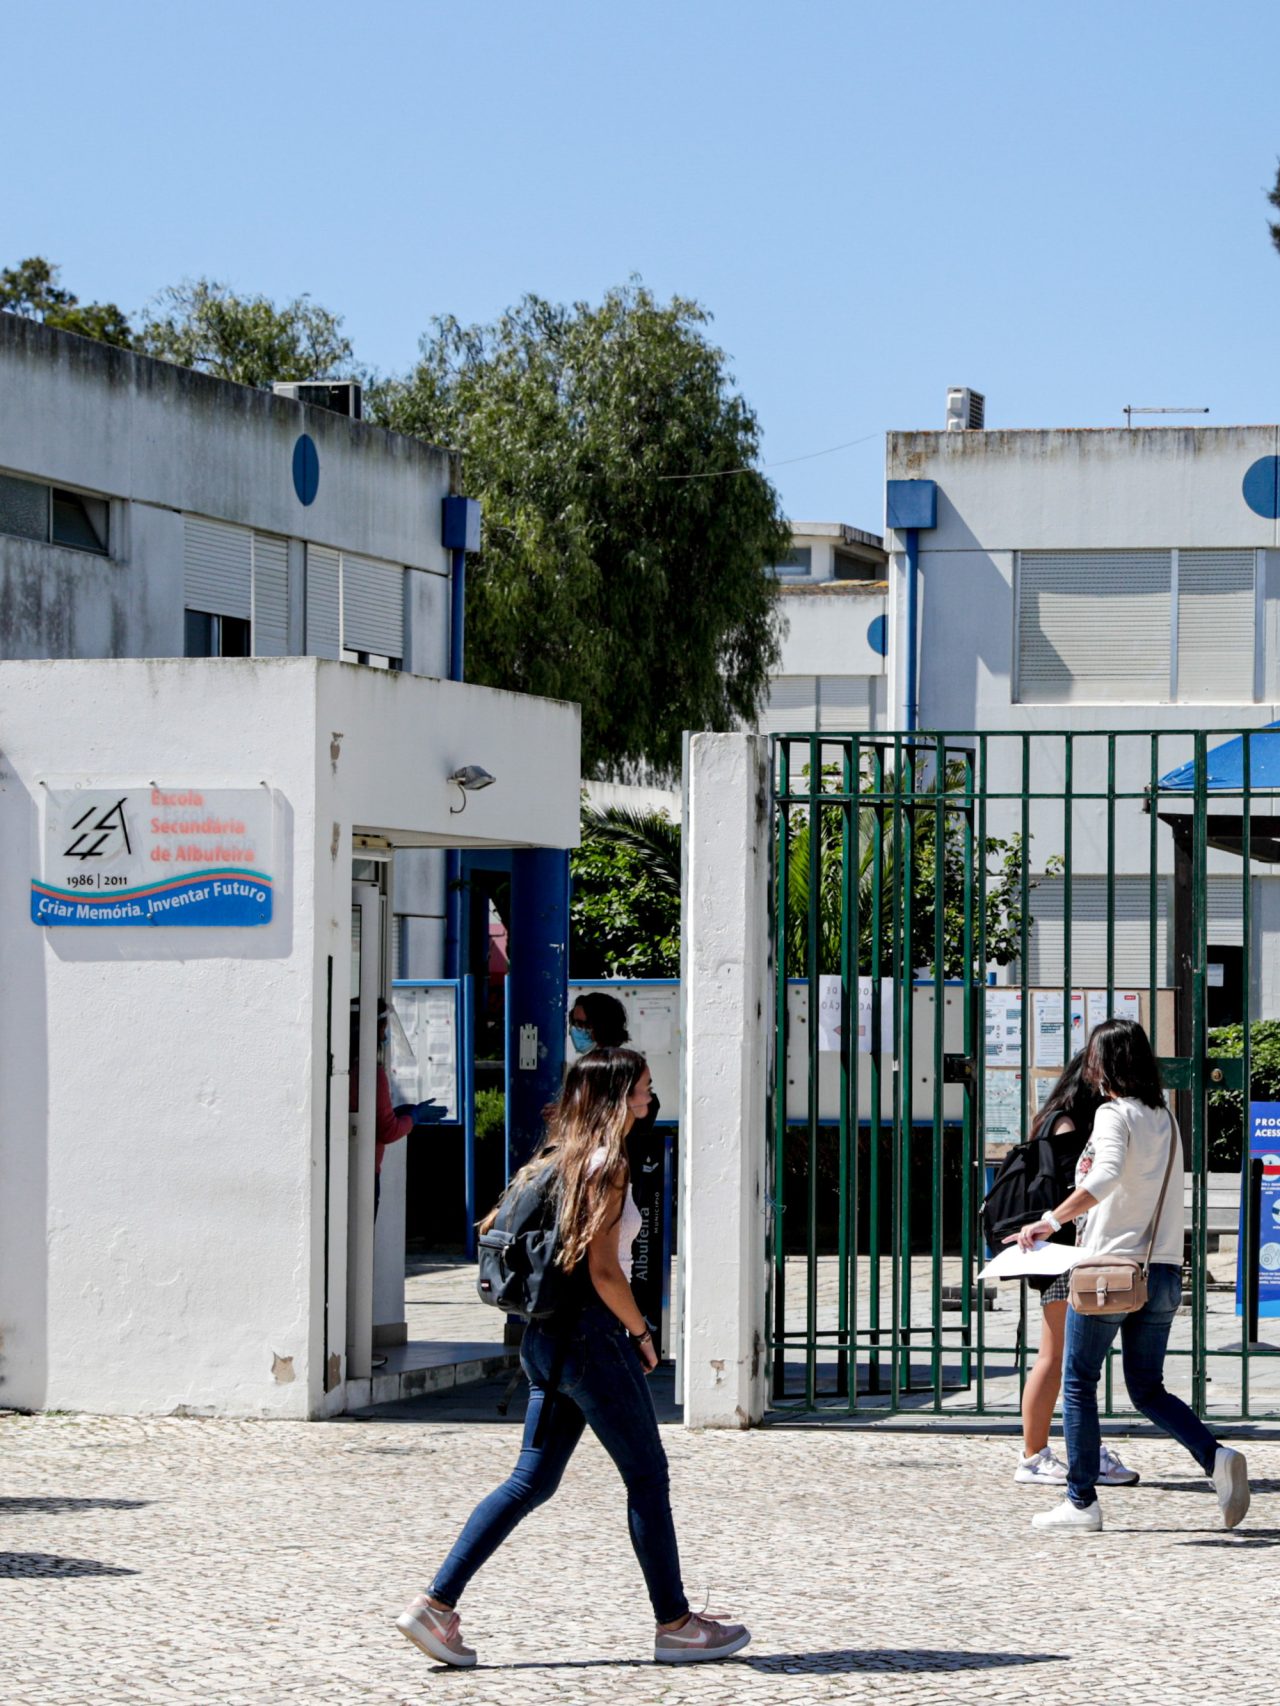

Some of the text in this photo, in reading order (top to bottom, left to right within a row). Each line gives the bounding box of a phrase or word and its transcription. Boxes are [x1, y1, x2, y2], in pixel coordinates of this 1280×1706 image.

[151, 790, 204, 806] Escola
[150, 818, 246, 835] Secundária
[150, 846, 256, 862] de Albufeira
[66, 874, 94, 886] 1986
[104, 876, 128, 886] 2011
[38, 898, 74, 918] Criar
[148, 882, 210, 914] Inventar
[213, 882, 267, 904] Futuro
